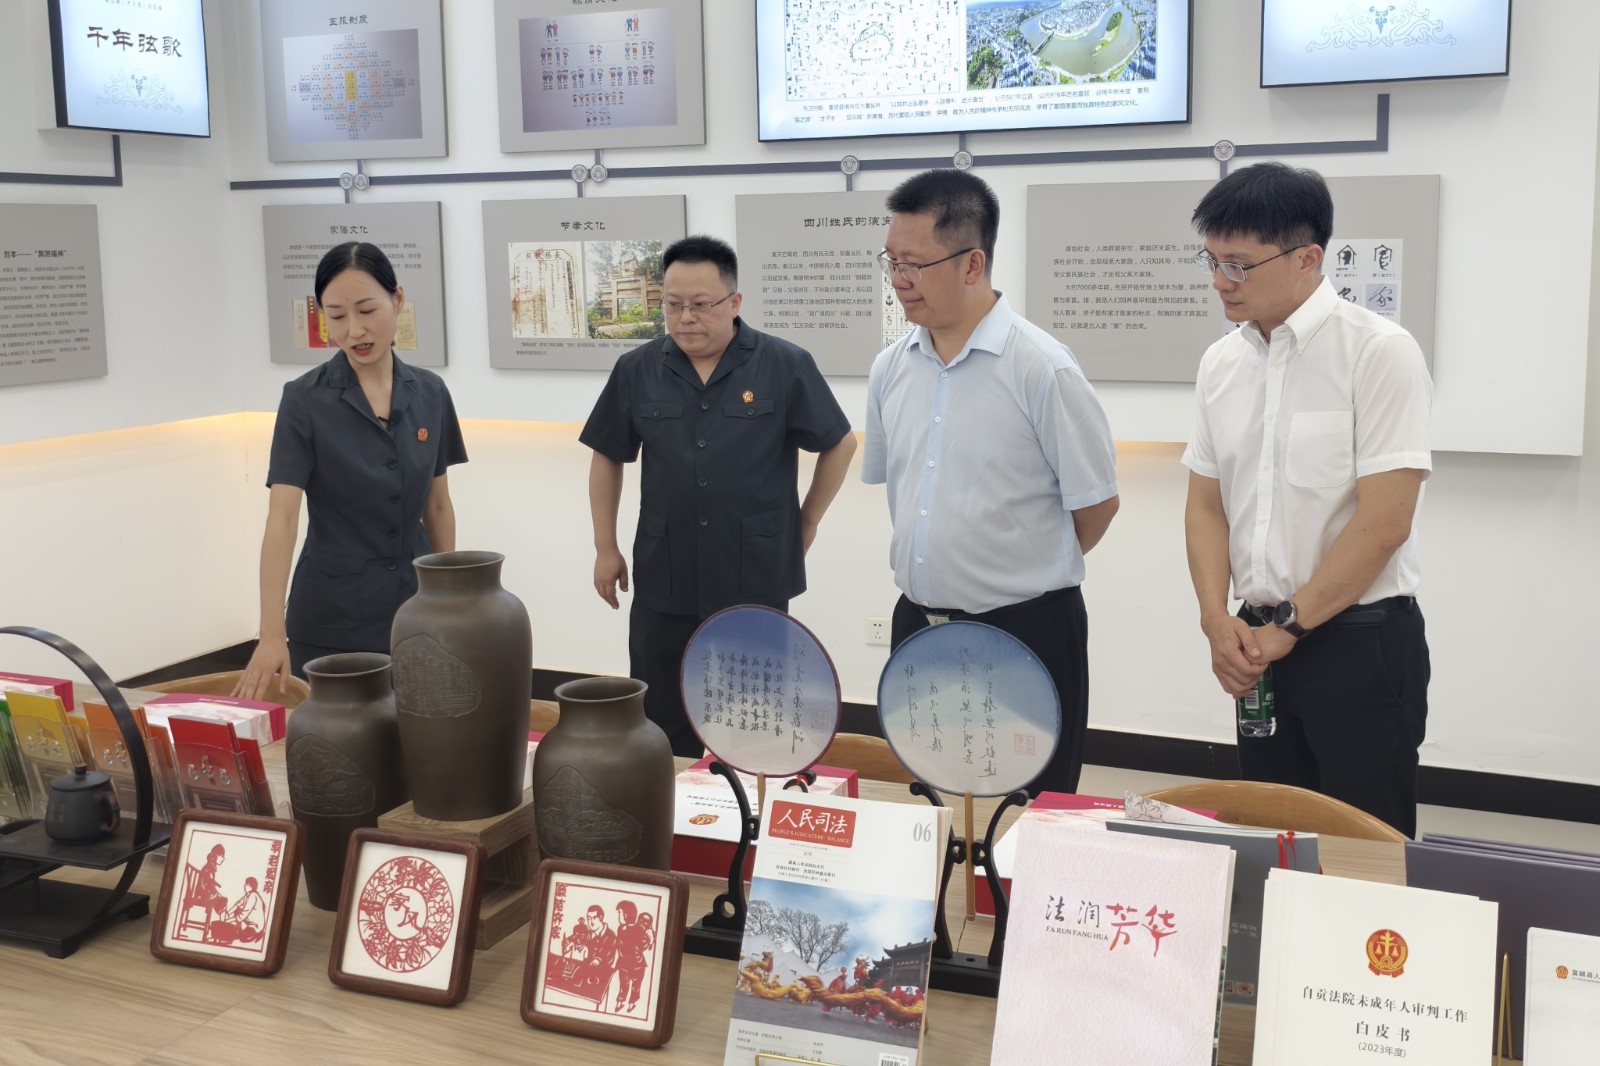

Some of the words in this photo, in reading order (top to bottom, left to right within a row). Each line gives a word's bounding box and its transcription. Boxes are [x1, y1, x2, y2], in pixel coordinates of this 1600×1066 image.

[86, 25, 182, 58] 千年弦歌
[776, 808, 849, 835] 人民司法
[912, 822, 932, 843] 06
[389, 893, 423, 931] 家风
[1046, 925, 1055, 933] FA
[1055, 927, 1072, 936] RUN
[1072, 930, 1092, 940] FANG
[1093, 933, 1109, 941] HUA
[1302, 985, 1469, 1024] 自贡法院未成年人审判工作
[1355, 1020, 1411, 1042] 白皮书
[1357, 1041, 1407, 1059] (2023年度)
